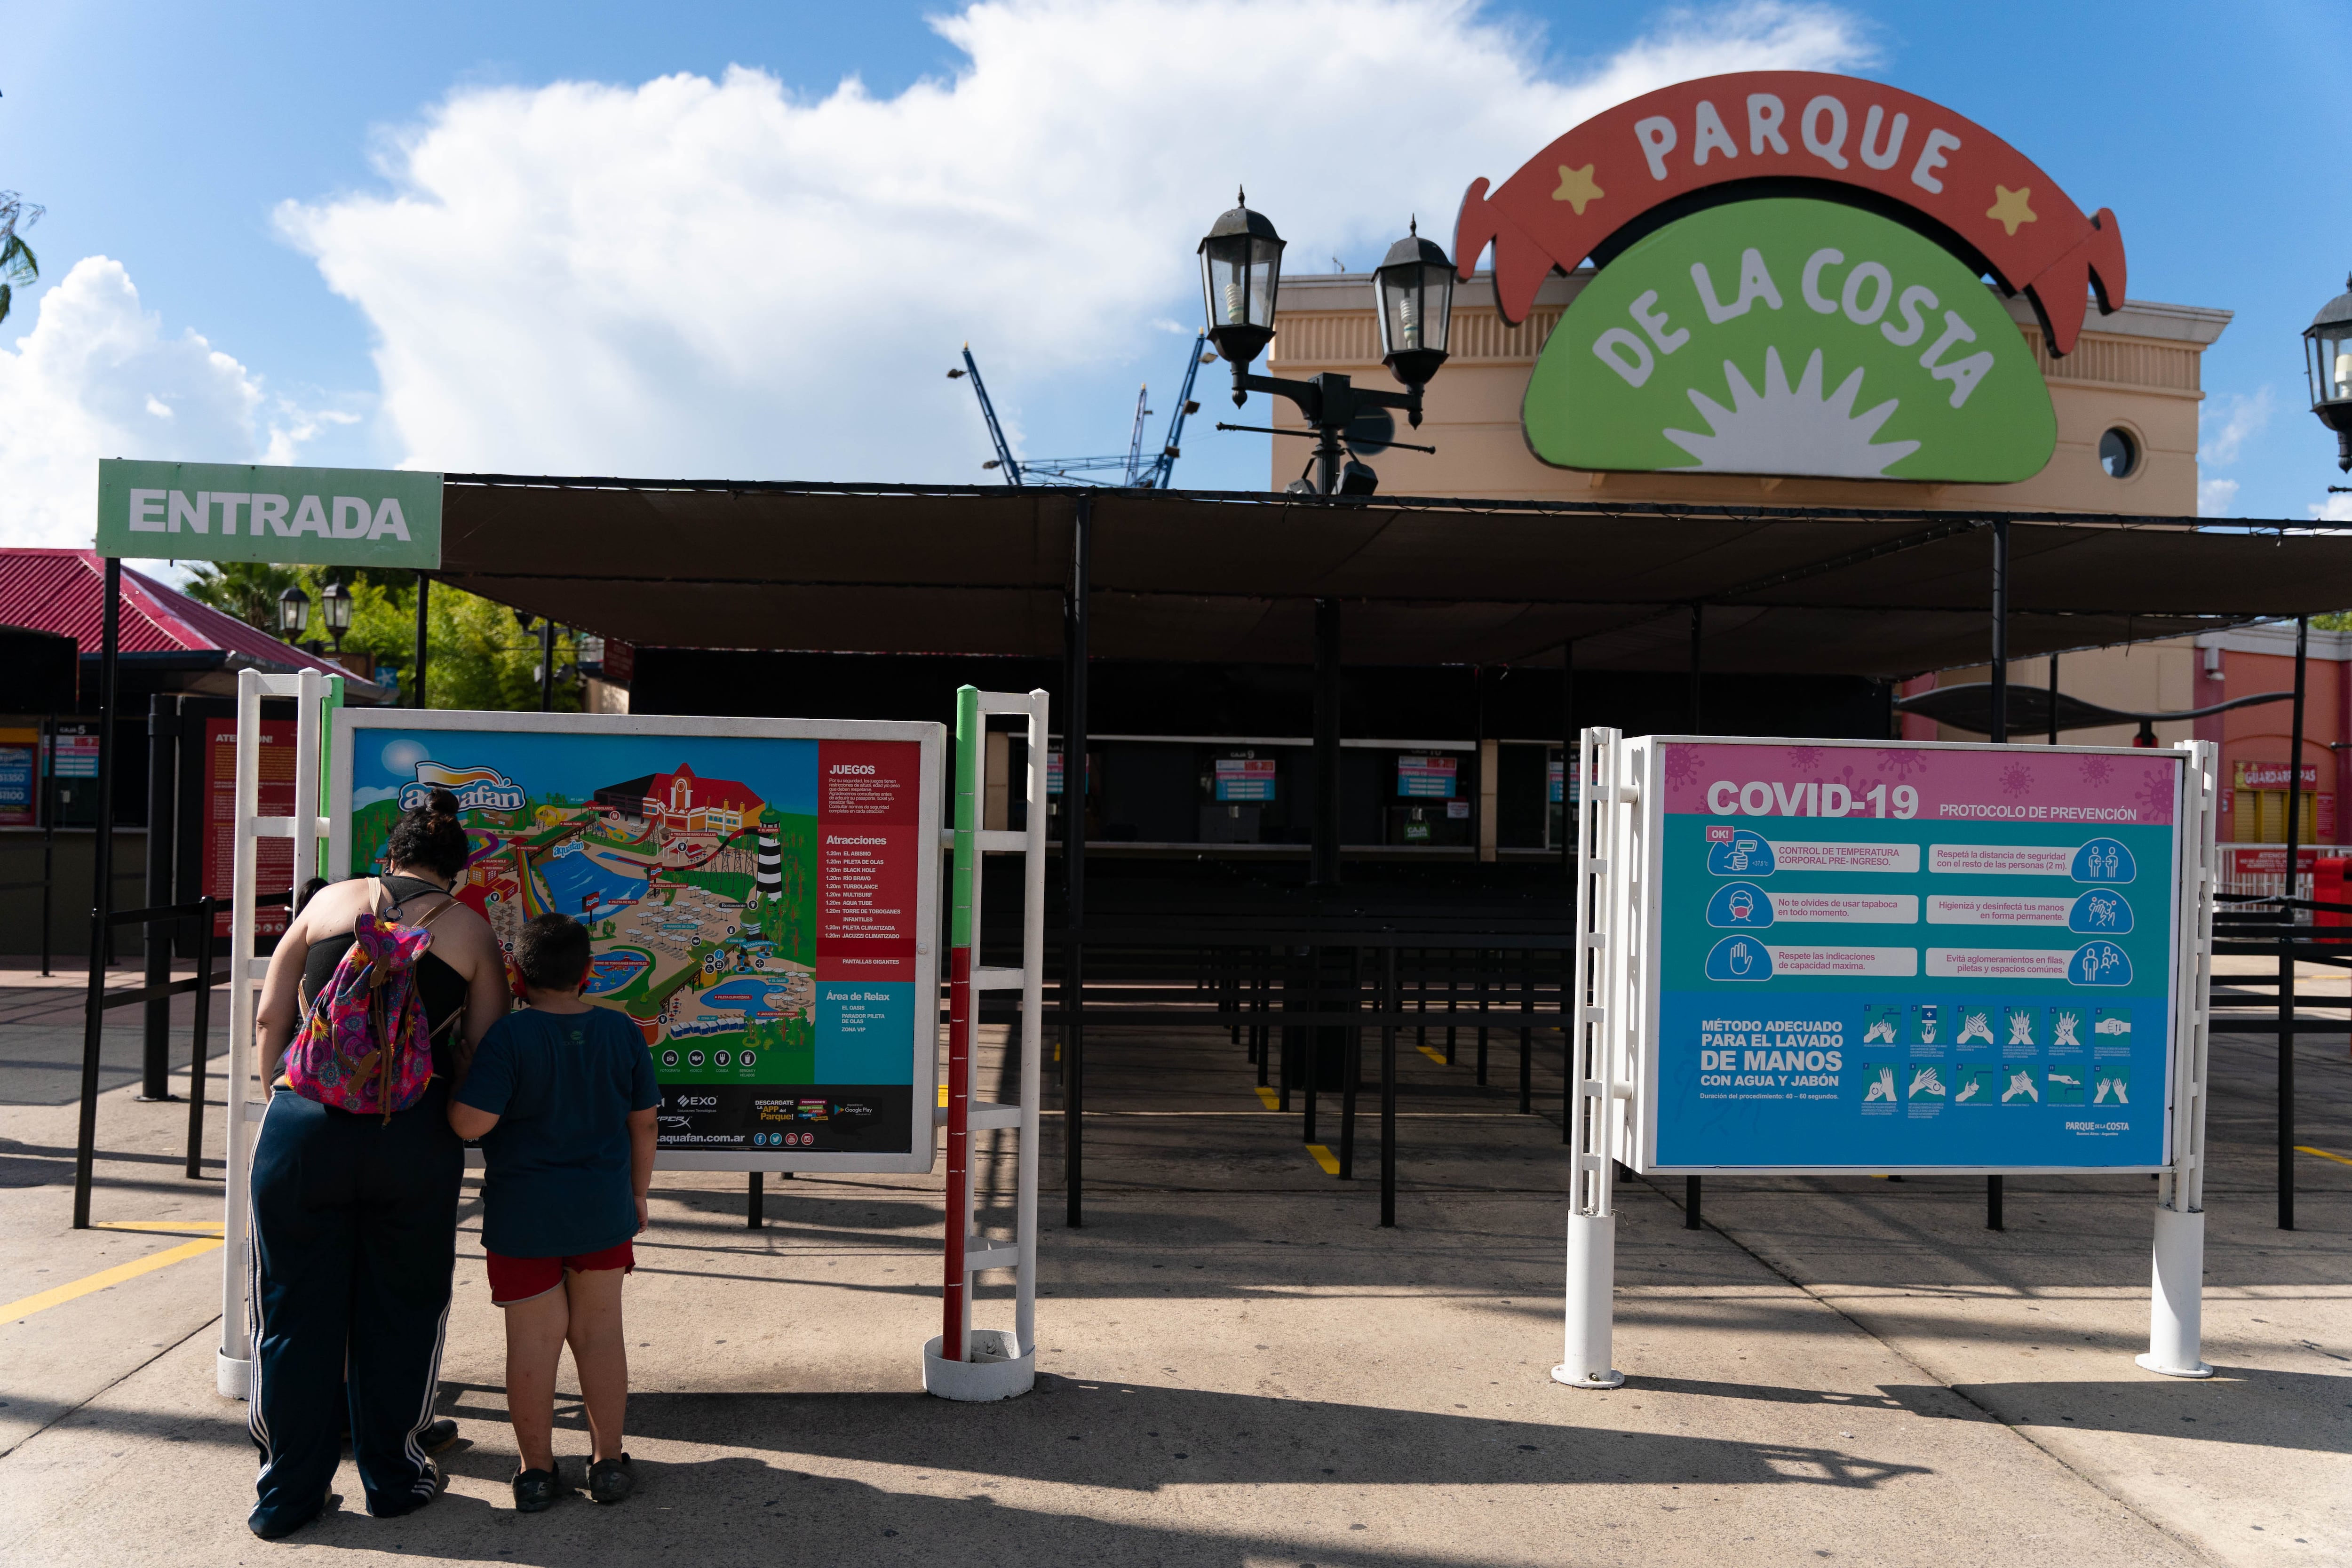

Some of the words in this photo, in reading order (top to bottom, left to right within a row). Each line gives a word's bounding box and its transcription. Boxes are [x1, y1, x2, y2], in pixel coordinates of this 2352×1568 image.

[1634, 94, 1961, 194] PARQUE
[1592, 289, 1690, 388] DE
[1690, 248, 1783, 324] LA
[1802, 248, 1994, 408] COSTA
[129, 488, 412, 541] ENTRADA
[829, 765, 875, 774] JUEGOS
[2245, 770, 2315, 784] GUARDARPAS
[405, 785, 520, 809] aafan
[1707, 780, 1919, 820] COVID-19
[1940, 804, 2025, 817] PROTOCOLO
[2029, 806, 2047, 818] DE
[2050, 804, 2136, 820] PREVENCIÓN
[826, 835, 886, 844] Atracciones
[554, 840, 584, 857] aquafan
[1938, 850, 1969, 860] Respetá
[2027, 852, 2066, 861] seguridad
[2046, 861, 2053, 870] (2
[2055, 862, 2066, 871] m).
[1861, 900, 1897, 909] tapaboca
[1939, 901, 1974, 910] Higienizá
[2016, 912, 2063, 922] permanente.
[1779, 952, 1811, 961] Respete
[1947, 955, 1965, 964] Evitá
[1967, 955, 2034, 964] aglomeramientos
[2047, 956, 2064, 965] filas,
[1790, 961, 1830, 971] capacidad
[1957, 964, 1982, 973] piletas
[1991, 965, 2025, 974] espacios
[826, 990, 848, 1000] Área
[1702, 1018, 1761, 1031] MÉTODO
[1765, 1019, 1842, 1032] ADECUADO
[1702, 1034, 1747, 1046] PARA
[1751, 1034, 1771, 1046] EL
[1776, 1034, 1843, 1047] LAVADO
[1701, 1051, 1736, 1070] DE
[1744, 1051, 1842, 1071] MANOS
[1701, 1075, 1731, 1085] CON
[1734, 1075, 1774, 1086] AGUA
[1778, 1075, 1788, 1086] Y
[1791, 1073, 1838, 1086] JABÓN
[760, 1113, 794, 1122] Parque!
[2066, 1122, 2094, 1131] PARQUE
[657, 1133, 745, 1144] .aquafan.com.ar
